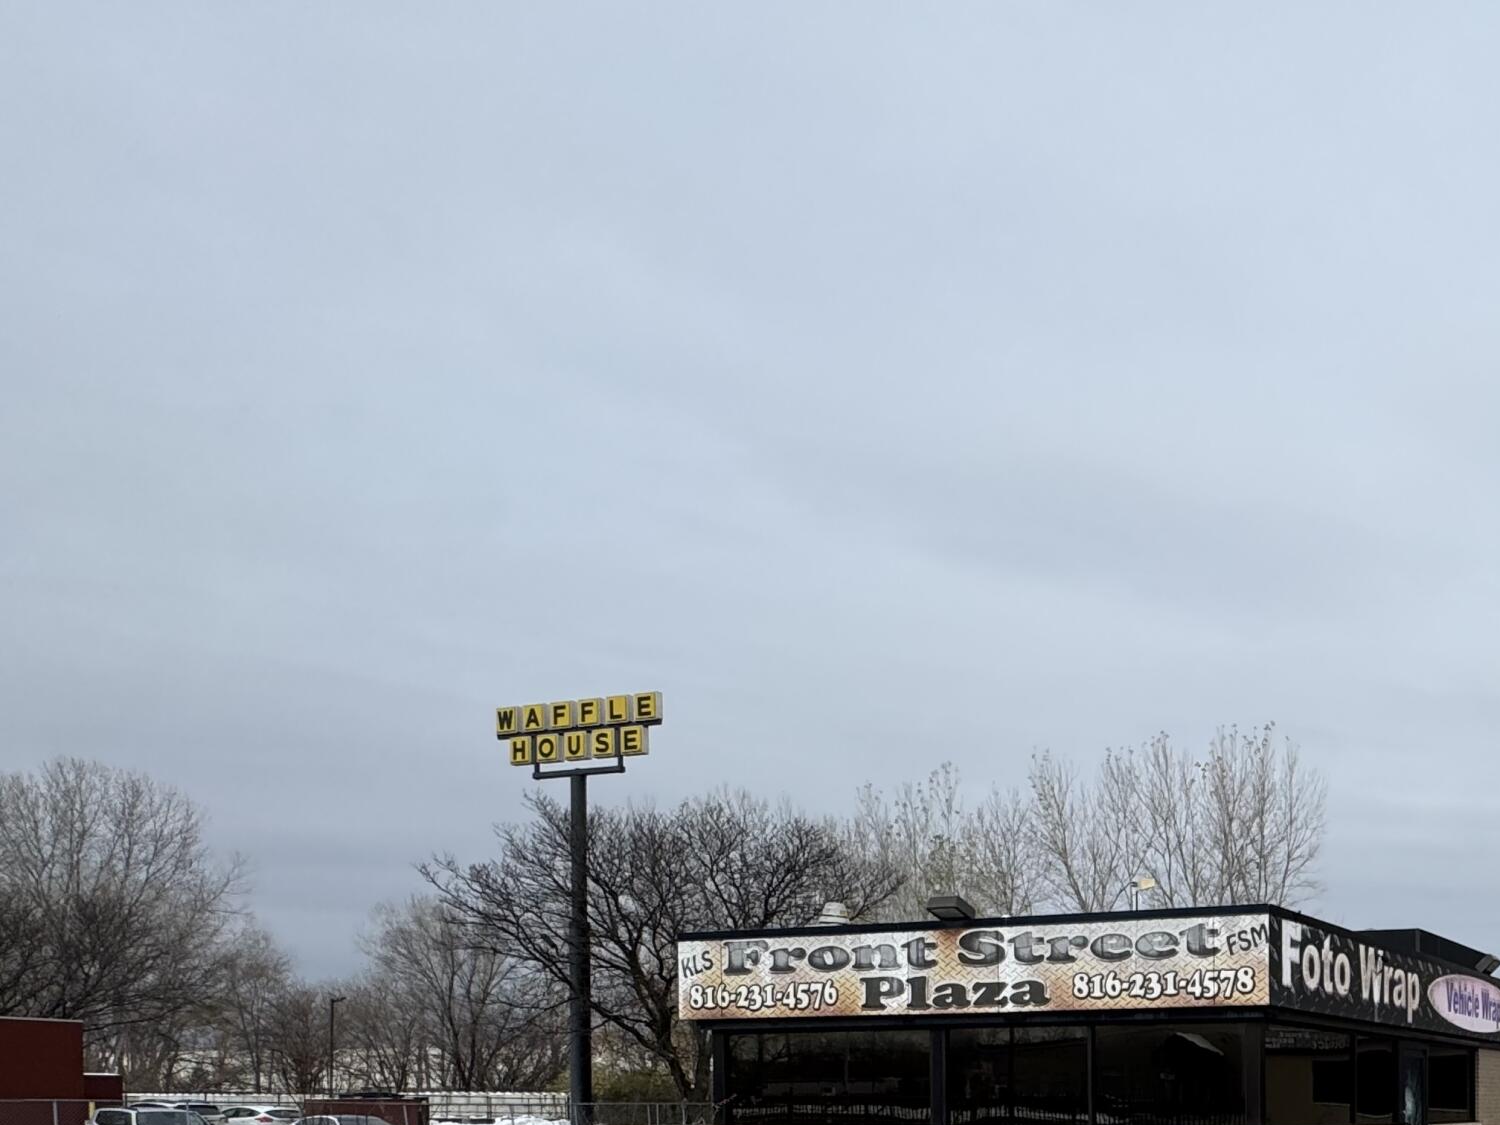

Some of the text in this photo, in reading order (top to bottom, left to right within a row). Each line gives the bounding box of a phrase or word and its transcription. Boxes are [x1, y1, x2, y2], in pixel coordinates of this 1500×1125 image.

[497, 695, 651, 731] WAFFLE
[513, 730, 638, 761] HOUSE
[681, 922, 1269, 978] KLS Front Street FSM
[1072, 966, 1256, 1000] 816-231-4578
[1281, 919, 1420, 1024] Foto Wrap
[688, 979, 839, 1011] 816-231-4576
[860, 975, 1050, 1011] Plaza
[1445, 978, 1479, 1018] Vehicle
